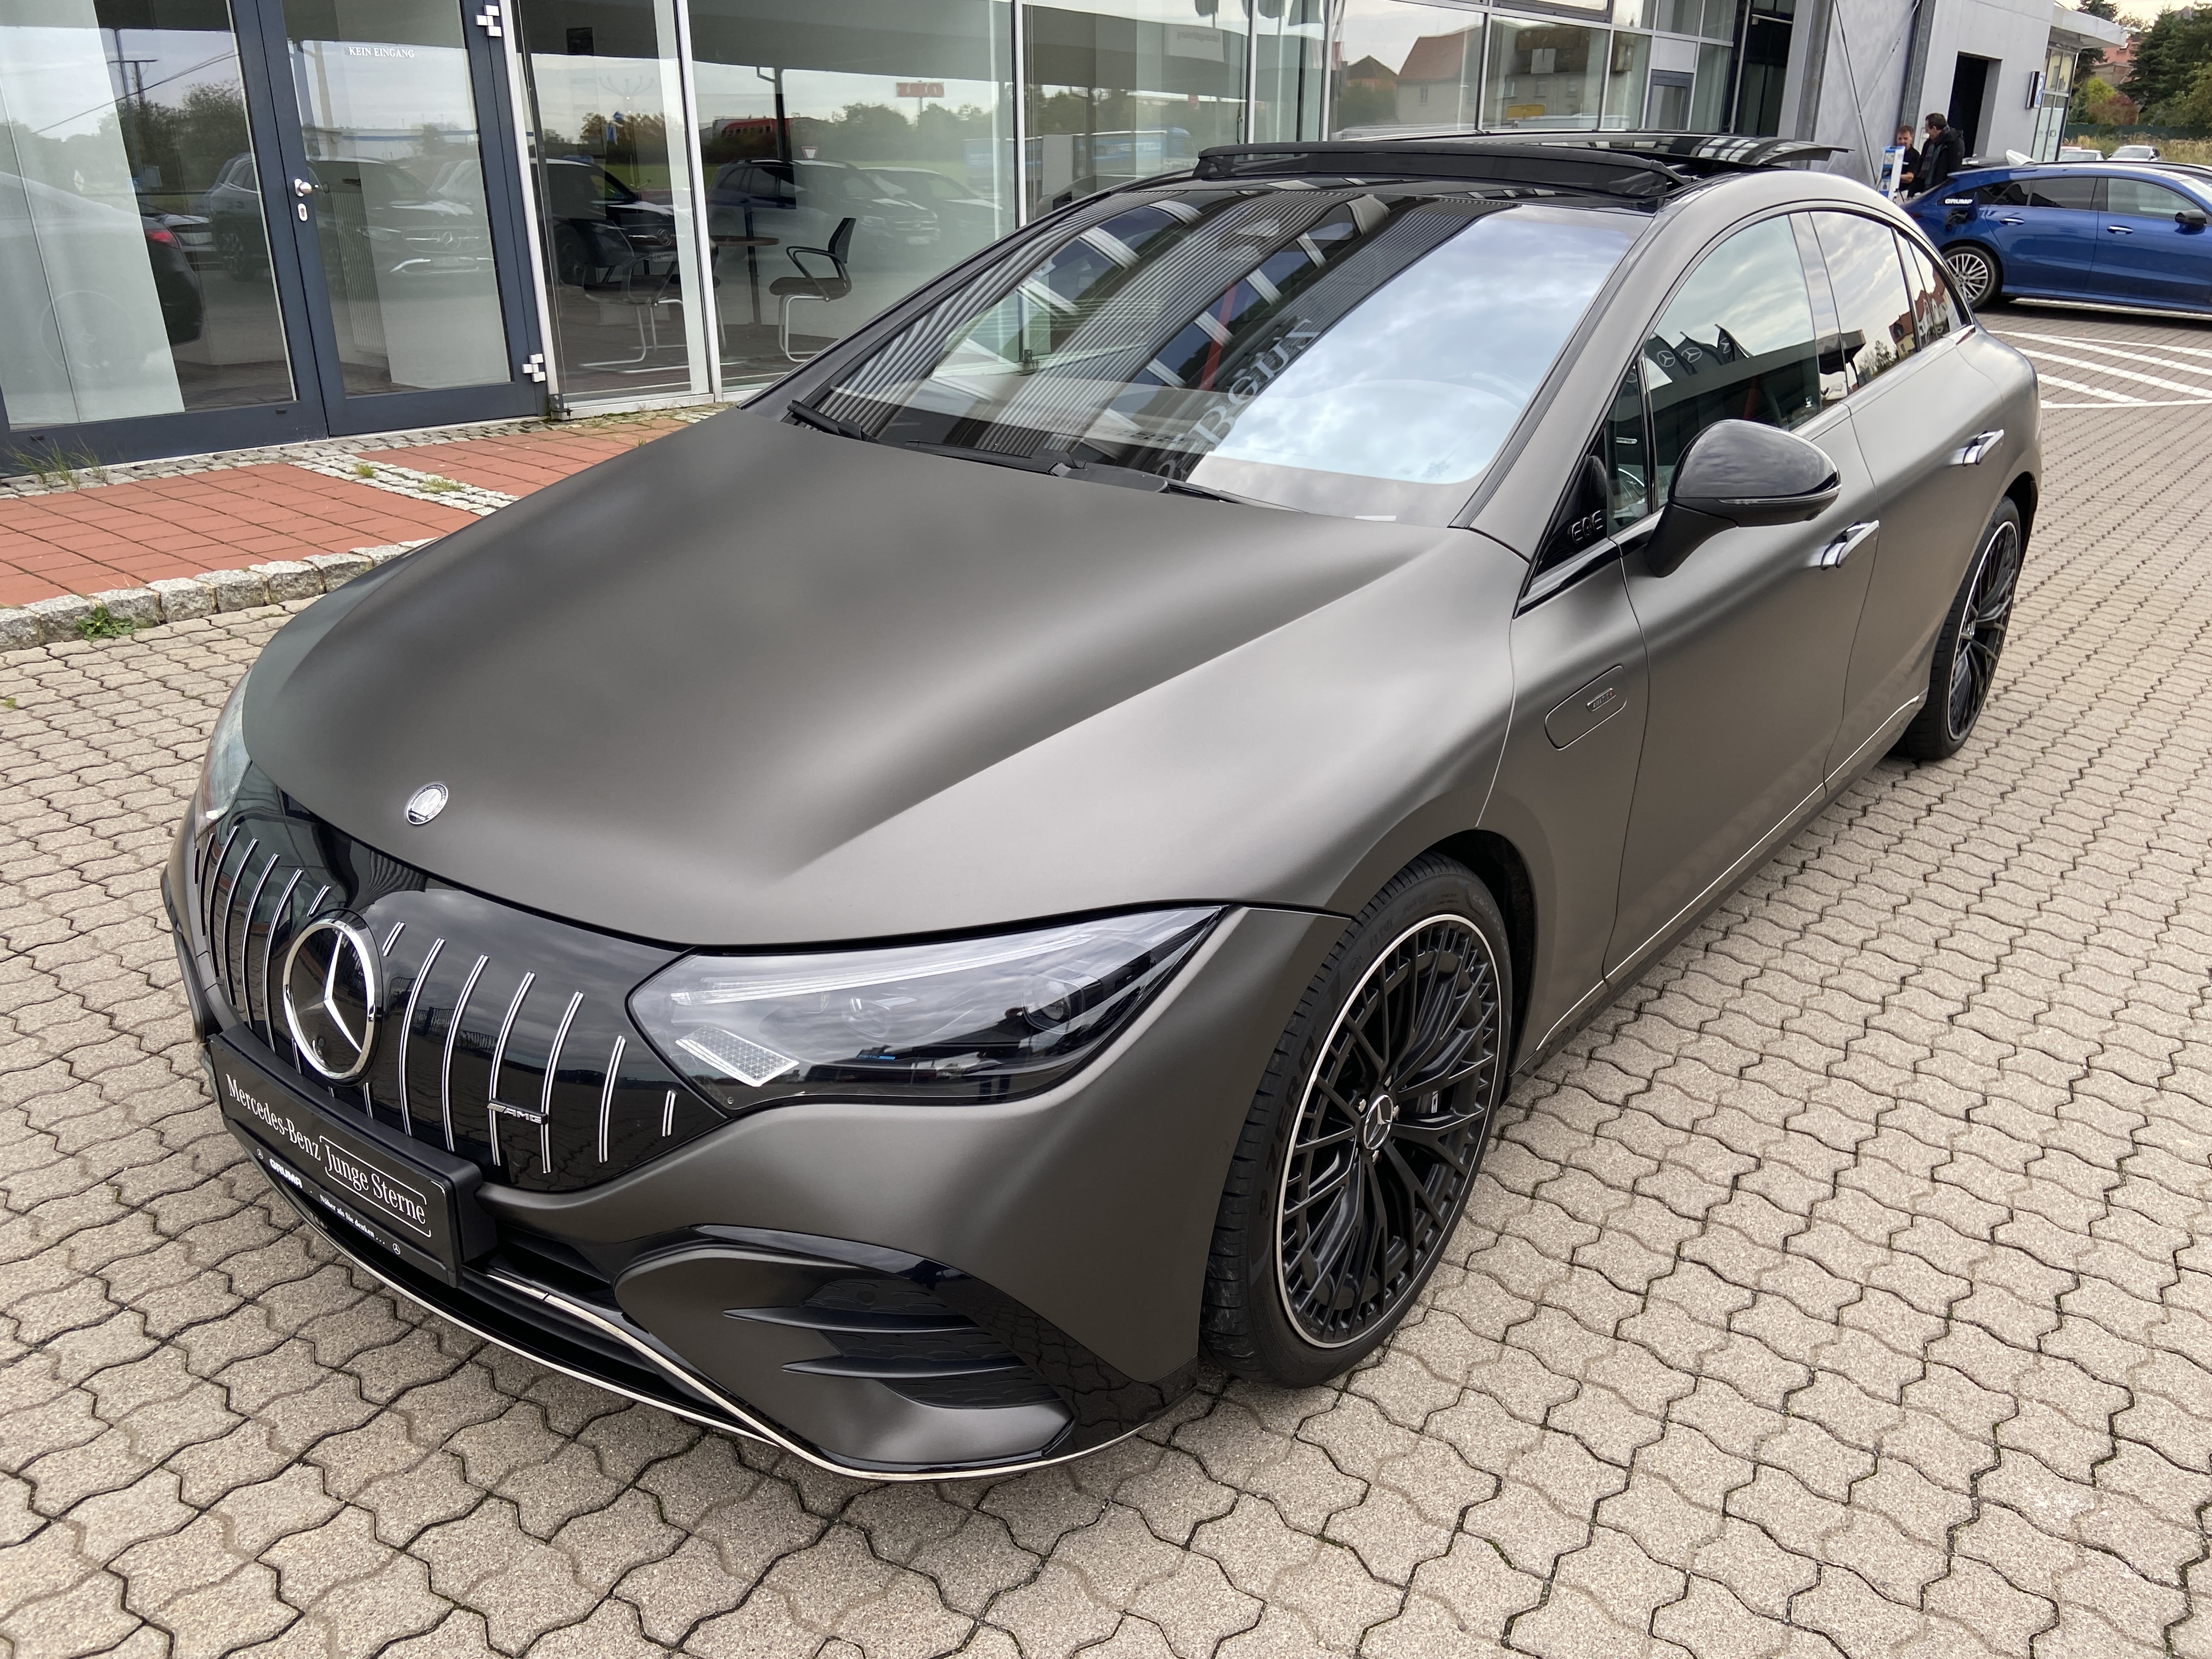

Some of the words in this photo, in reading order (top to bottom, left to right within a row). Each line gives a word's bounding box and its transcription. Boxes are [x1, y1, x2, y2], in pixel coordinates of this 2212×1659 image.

[348, 46, 371, 57] KEIN
[373, 47, 415, 58] EINGANG
[1570, 510, 1604, 544] EQE
[503, 1107, 542, 1125] AMG
[225, 1074, 321, 1161] Mercedes-Benz
[324, 1144, 369, 1192] Junge
[371, 1173, 426, 1225] Sterne
[269, 1158, 303, 1189] GRUMA
[336, 1207, 345, 1218] als
[345, 1211, 354, 1224] Sie
[354, 1218, 375, 1238] denken
